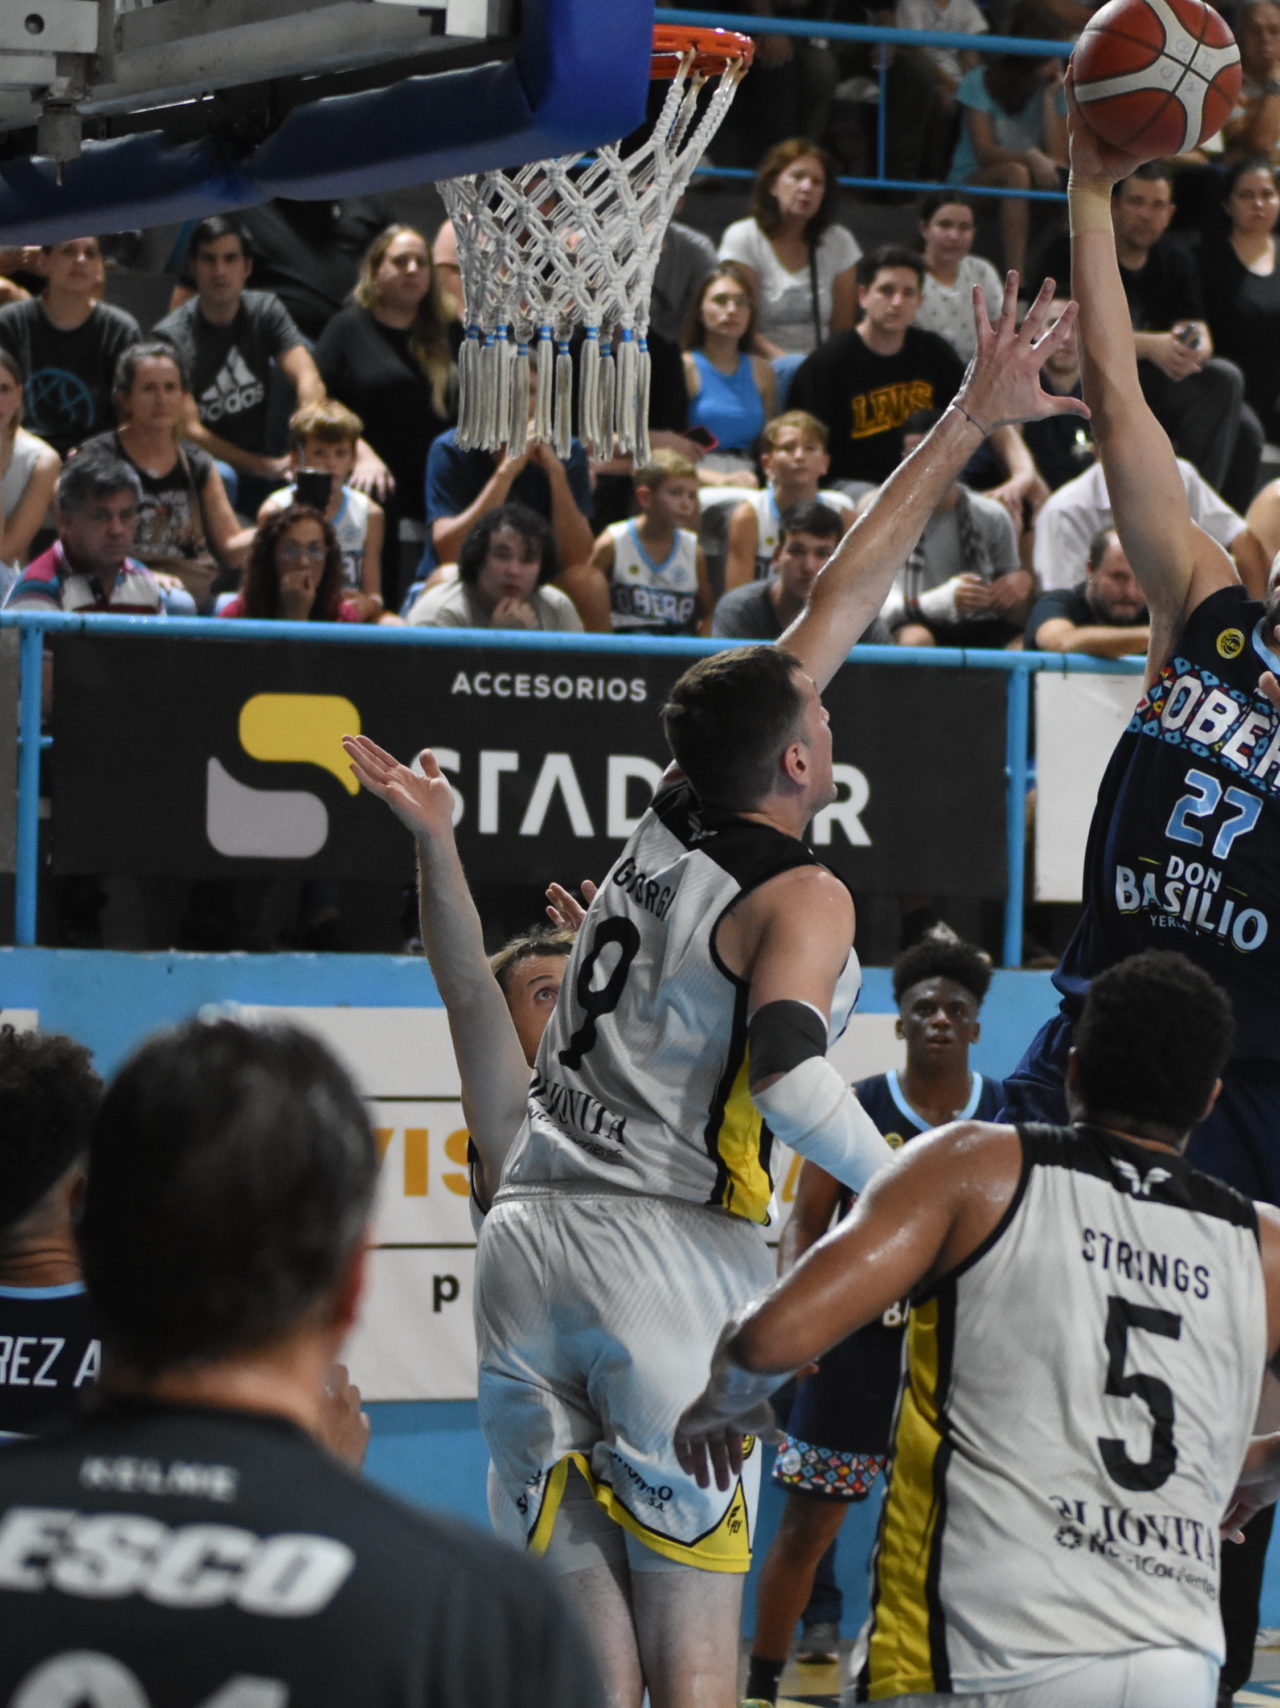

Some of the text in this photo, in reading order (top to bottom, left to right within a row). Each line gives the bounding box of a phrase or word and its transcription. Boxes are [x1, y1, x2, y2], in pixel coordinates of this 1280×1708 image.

[452, 672, 648, 701] ACCESORIOS
[1165, 768, 1264, 860] 27
[1115, 864, 1268, 951] BASILIO
[1166, 854, 1222, 893] DON
[559, 915, 641, 1071] 9
[1082, 1227, 1211, 1300] STRINGS
[1097, 1294, 1183, 1492] 5
